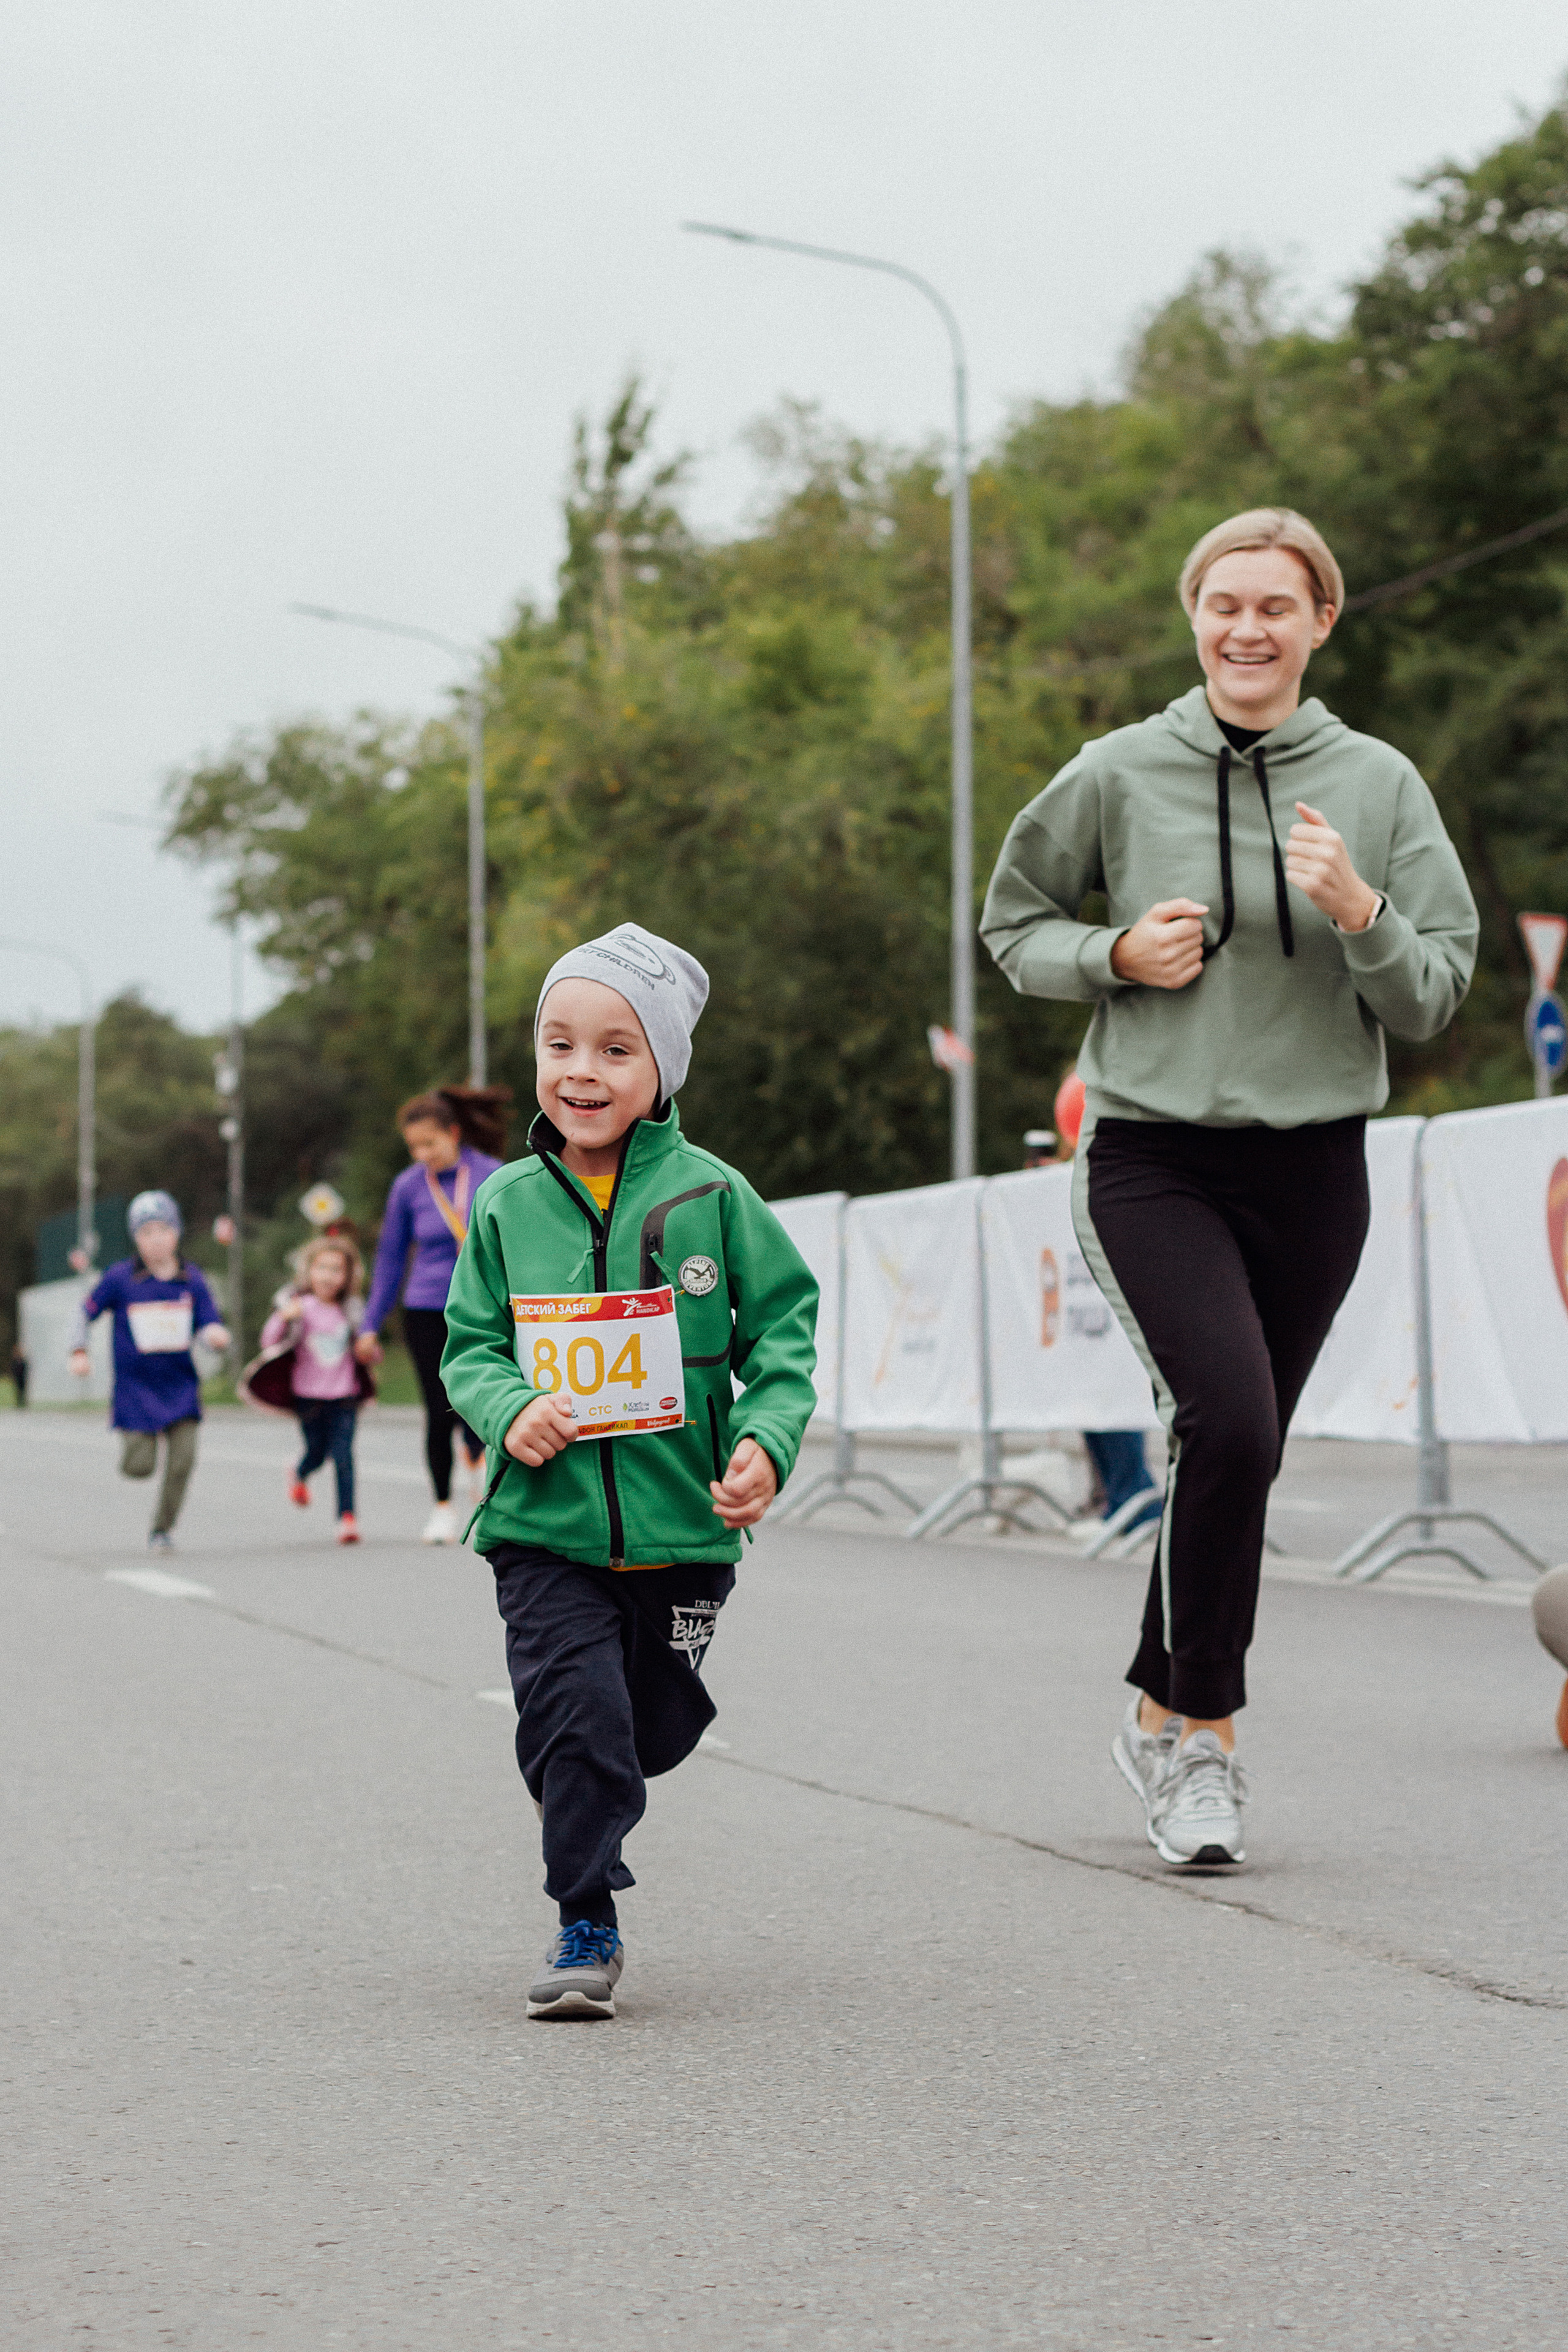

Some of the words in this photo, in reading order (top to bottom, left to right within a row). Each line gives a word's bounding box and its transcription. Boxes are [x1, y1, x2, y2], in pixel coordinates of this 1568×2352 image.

[516, 1302, 556, 1316] ДЕТСКИЙ
[558, 1303, 592, 1315] ЗАБЕГ
[532, 1333, 648, 1396] 804
